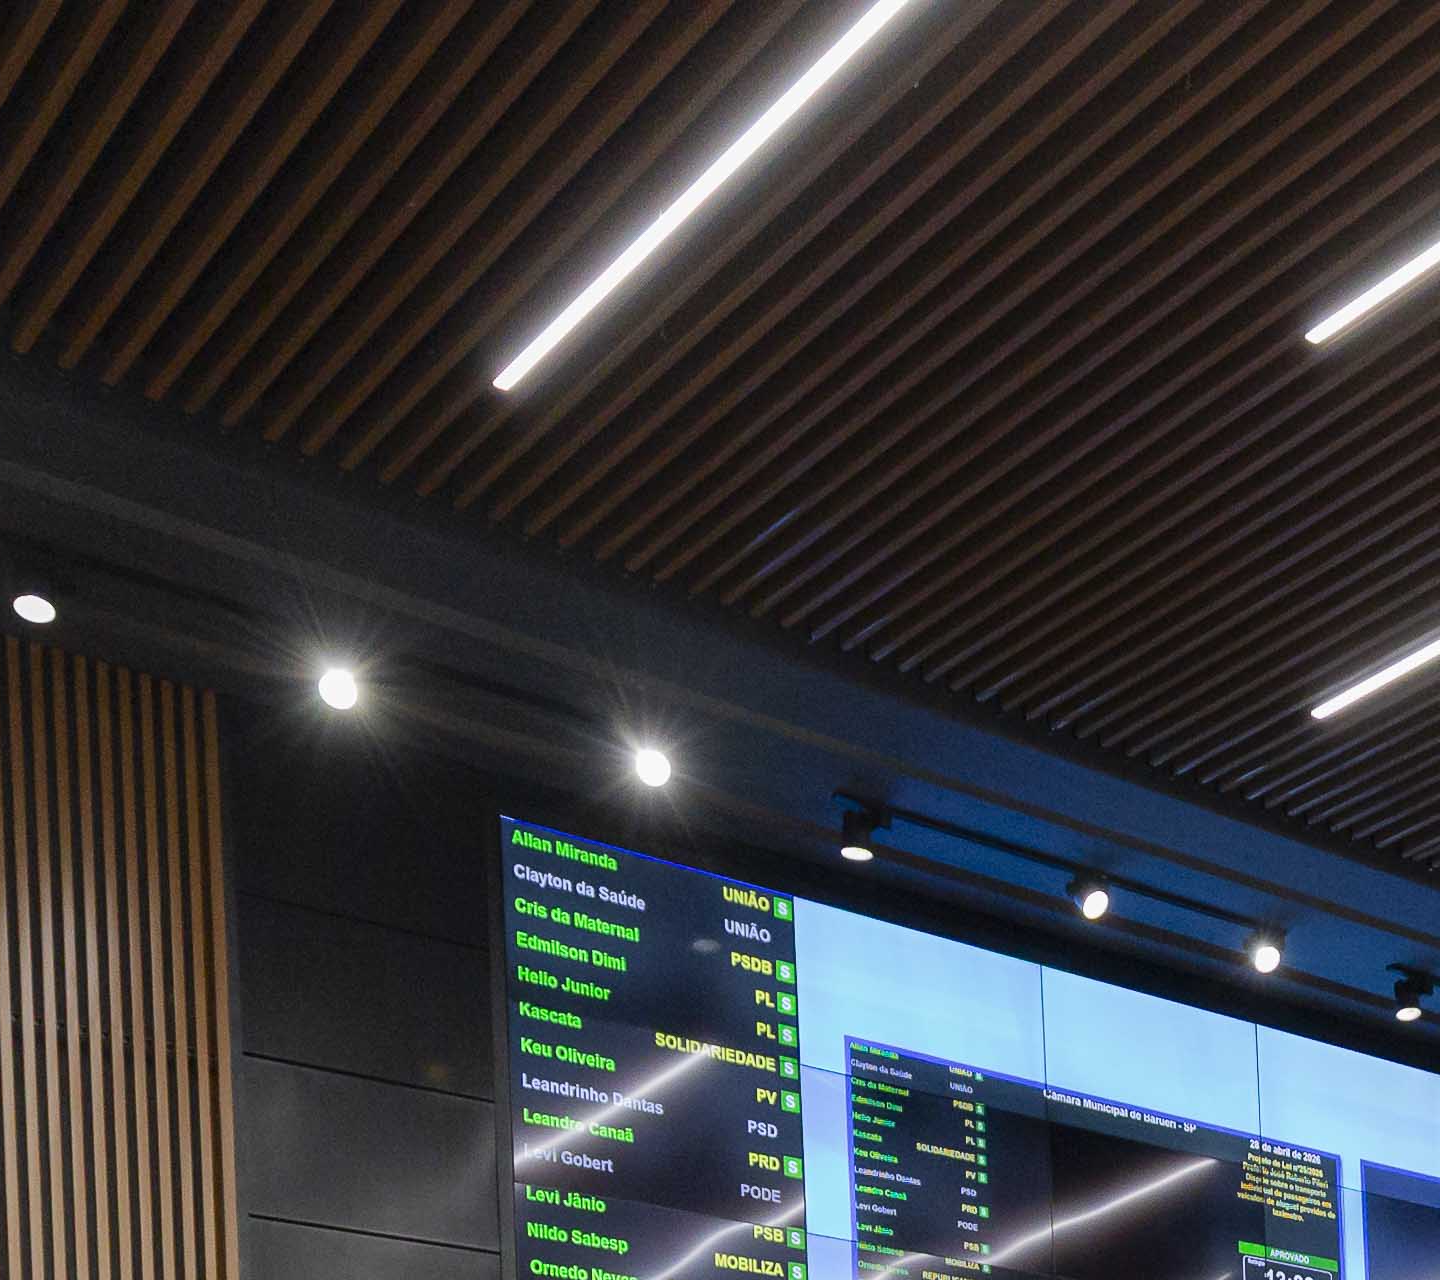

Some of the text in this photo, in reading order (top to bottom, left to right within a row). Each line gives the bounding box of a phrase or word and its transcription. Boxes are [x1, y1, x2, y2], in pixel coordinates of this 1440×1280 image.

[511, 829, 617, 871] Allan Miranda
[513, 863, 645, 911] Clayton da Saúde
[722, 885, 787, 916] UNIÃO S
[514, 897, 639, 942] Cris da Maternal
[724, 917, 771, 943] UNIÃO
[516, 930, 626, 971] Edmilson Dimi
[731, 951, 790, 979] PSDB S
[517, 964, 610, 1000] Helio Junior
[755, 989, 791, 1011] PL S
[519, 1000, 582, 1029] Kascata
[756, 1021, 792, 1043] PL S
[520, 1036, 615, 1071] Keu Oliveira
[655, 1031, 793, 1075] SOLIDARIEDADE S
[522, 1072, 663, 1115] Leandrinho Dantas
[756, 1087, 795, 1109] PV S
[523, 1107, 633, 1142] Leandro Canaã
[747, 1119, 777, 1138] PSD
[560, 1149, 613, 1172] Gobert
[748, 1151, 798, 1174] PRD S
[526, 1185, 606, 1212] Levi Jânio
[740, 1183, 781, 1203] PODE
[527, 1221, 628, 1255] Nildo Sabesp
[753, 1224, 800, 1245] PSB S
[529, 1258, 588, 1280] Ornedo
[714, 1252, 801, 1279] MOBILIZA S
[1269, 1248, 1309, 1264] APROVADO
